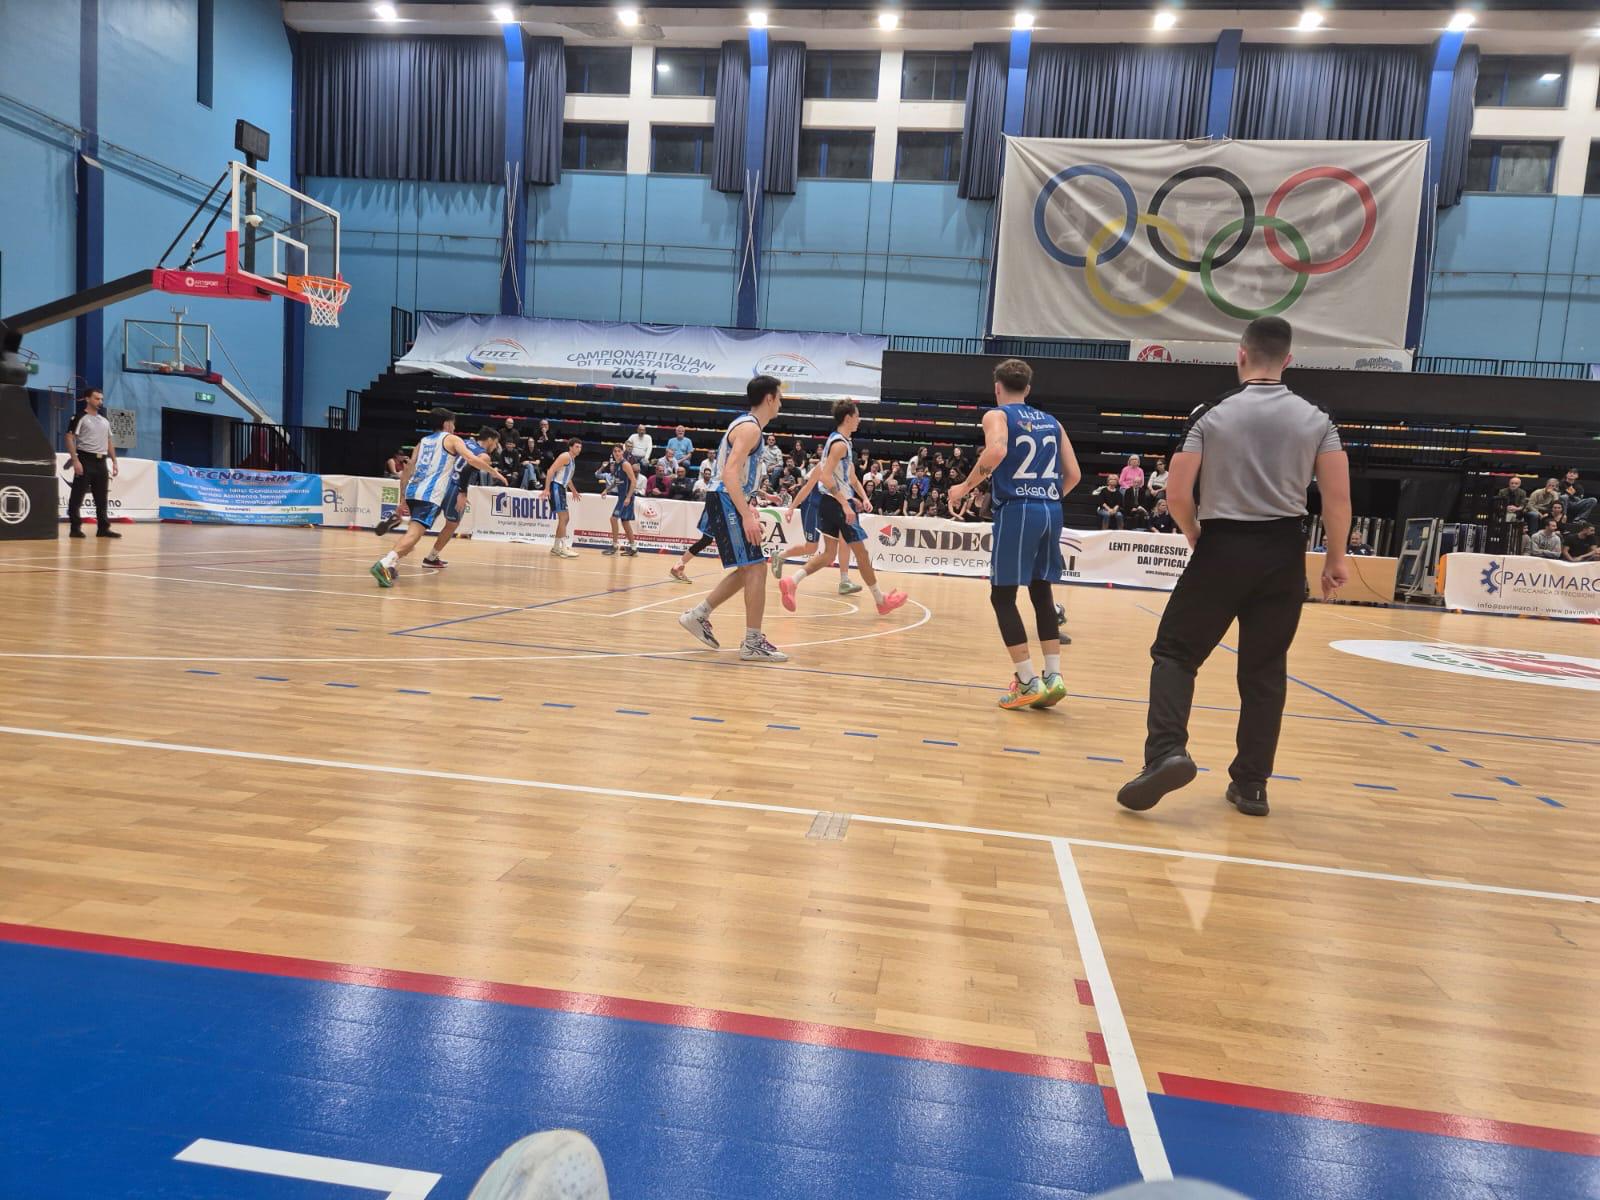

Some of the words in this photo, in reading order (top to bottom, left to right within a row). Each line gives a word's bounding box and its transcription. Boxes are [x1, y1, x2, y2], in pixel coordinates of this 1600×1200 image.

[567, 350, 657, 362] CAMPIONATI
[659, 352, 716, 371] ITALIANI
[594, 358, 700, 374] TENNISTAVOLO
[611, 367, 657, 385] 2024
[1012, 435, 1058, 479] 22
[188, 469, 292, 482] TECNOTERM
[1015, 483, 1046, 496] ekso
[1109, 542, 1131, 551] LENTI
[1133, 543, 1188, 556] PROGRESSIVE
[877, 553, 884, 561] A
[889, 554, 919, 563] TOOL
[925, 556, 948, 565] FOR
[953, 558, 991, 568] EVERY
[1137, 556, 1152, 565] DAI
[1154, 557, 1187, 568] OPTICAL
[1513, 587, 1552, 595] MECCANICA
